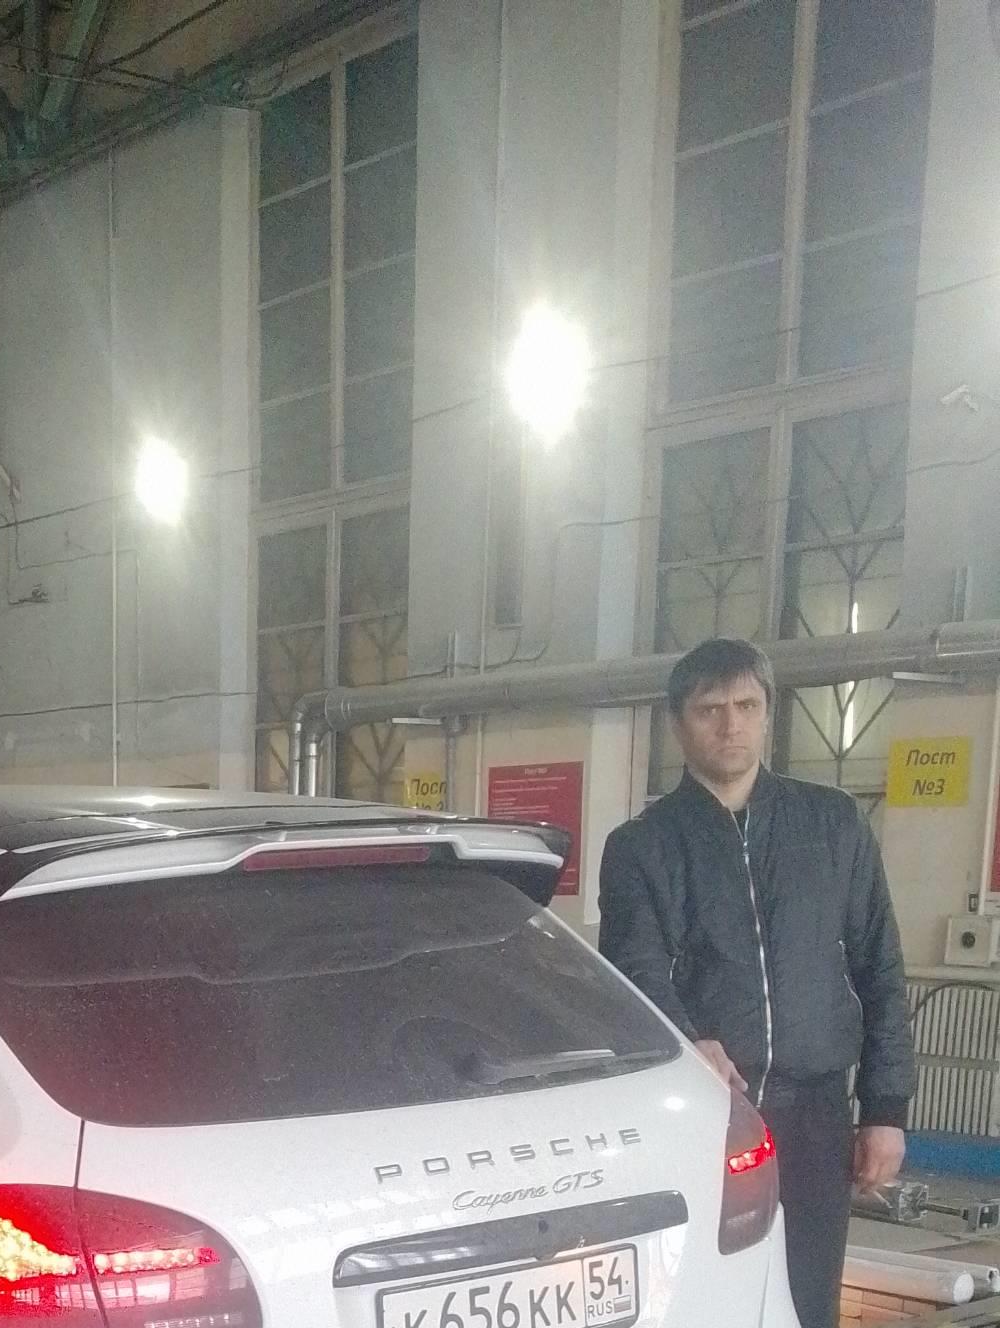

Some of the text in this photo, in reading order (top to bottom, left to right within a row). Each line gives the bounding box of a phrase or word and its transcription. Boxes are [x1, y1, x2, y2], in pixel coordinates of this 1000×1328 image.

[905, 749, 956, 767] Пост
[912, 779, 945, 796] №3
[374, 1127, 642, 1184] PORSCHE
[452, 1168, 605, 1215] Cayenne GTS
[588, 1256, 623, 1301] 54
[587, 1301, 613, 1321] RUS
